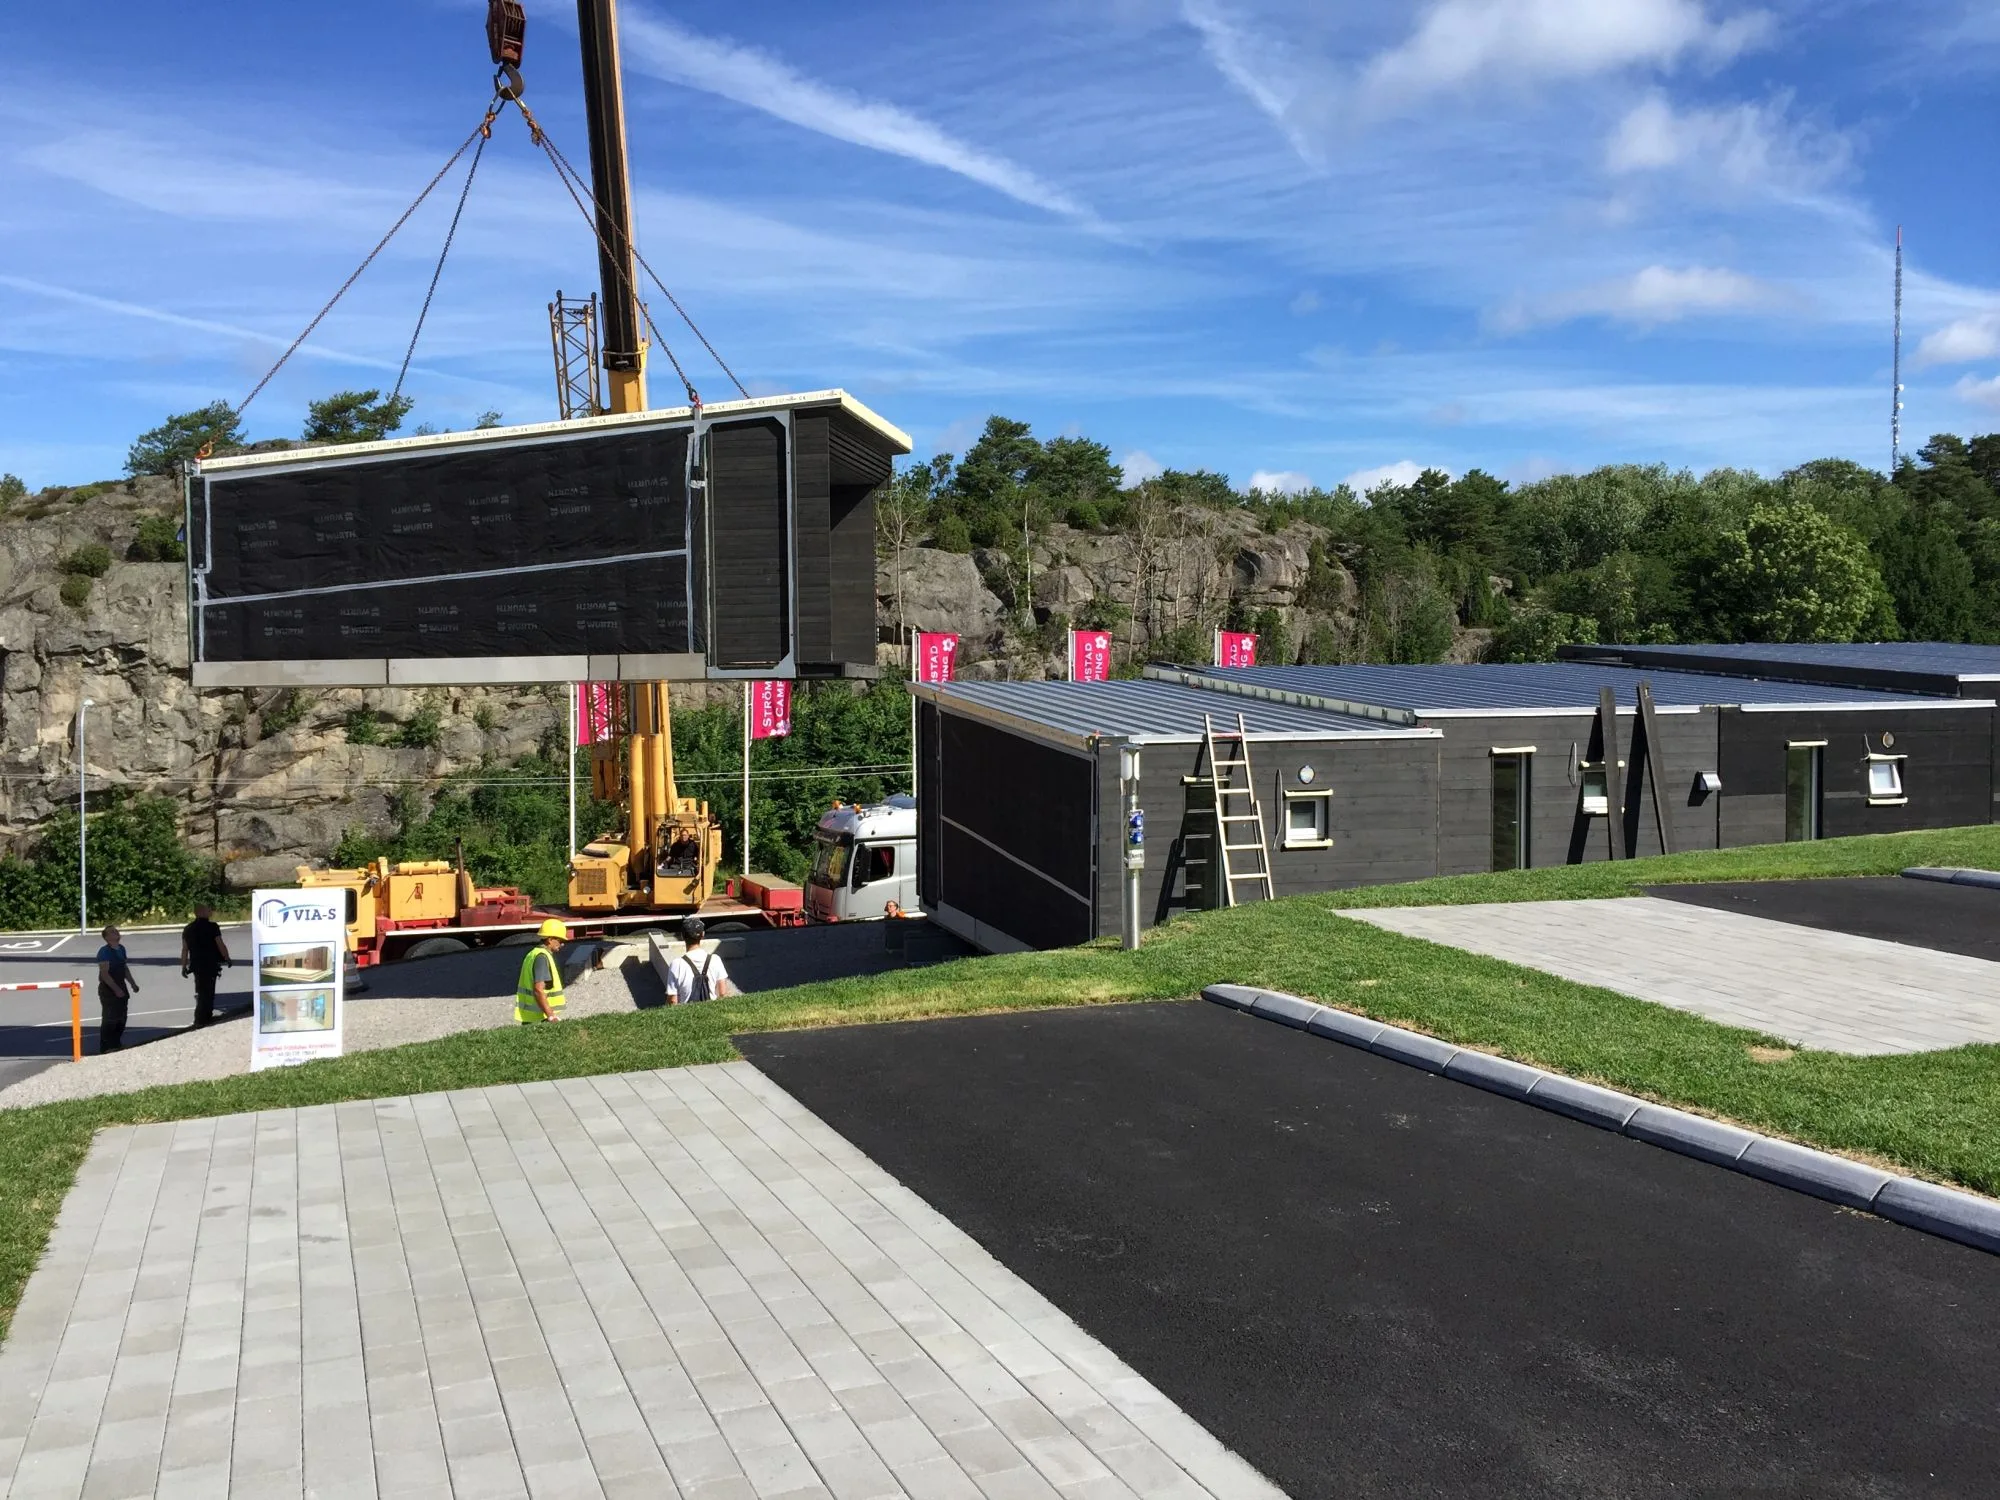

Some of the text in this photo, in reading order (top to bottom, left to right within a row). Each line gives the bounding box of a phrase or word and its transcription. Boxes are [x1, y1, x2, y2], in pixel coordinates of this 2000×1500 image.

[930, 645, 938, 683] STAD
[761, 681, 773, 728] STRÖM
[293, 908, 337, 921] VIA-S
